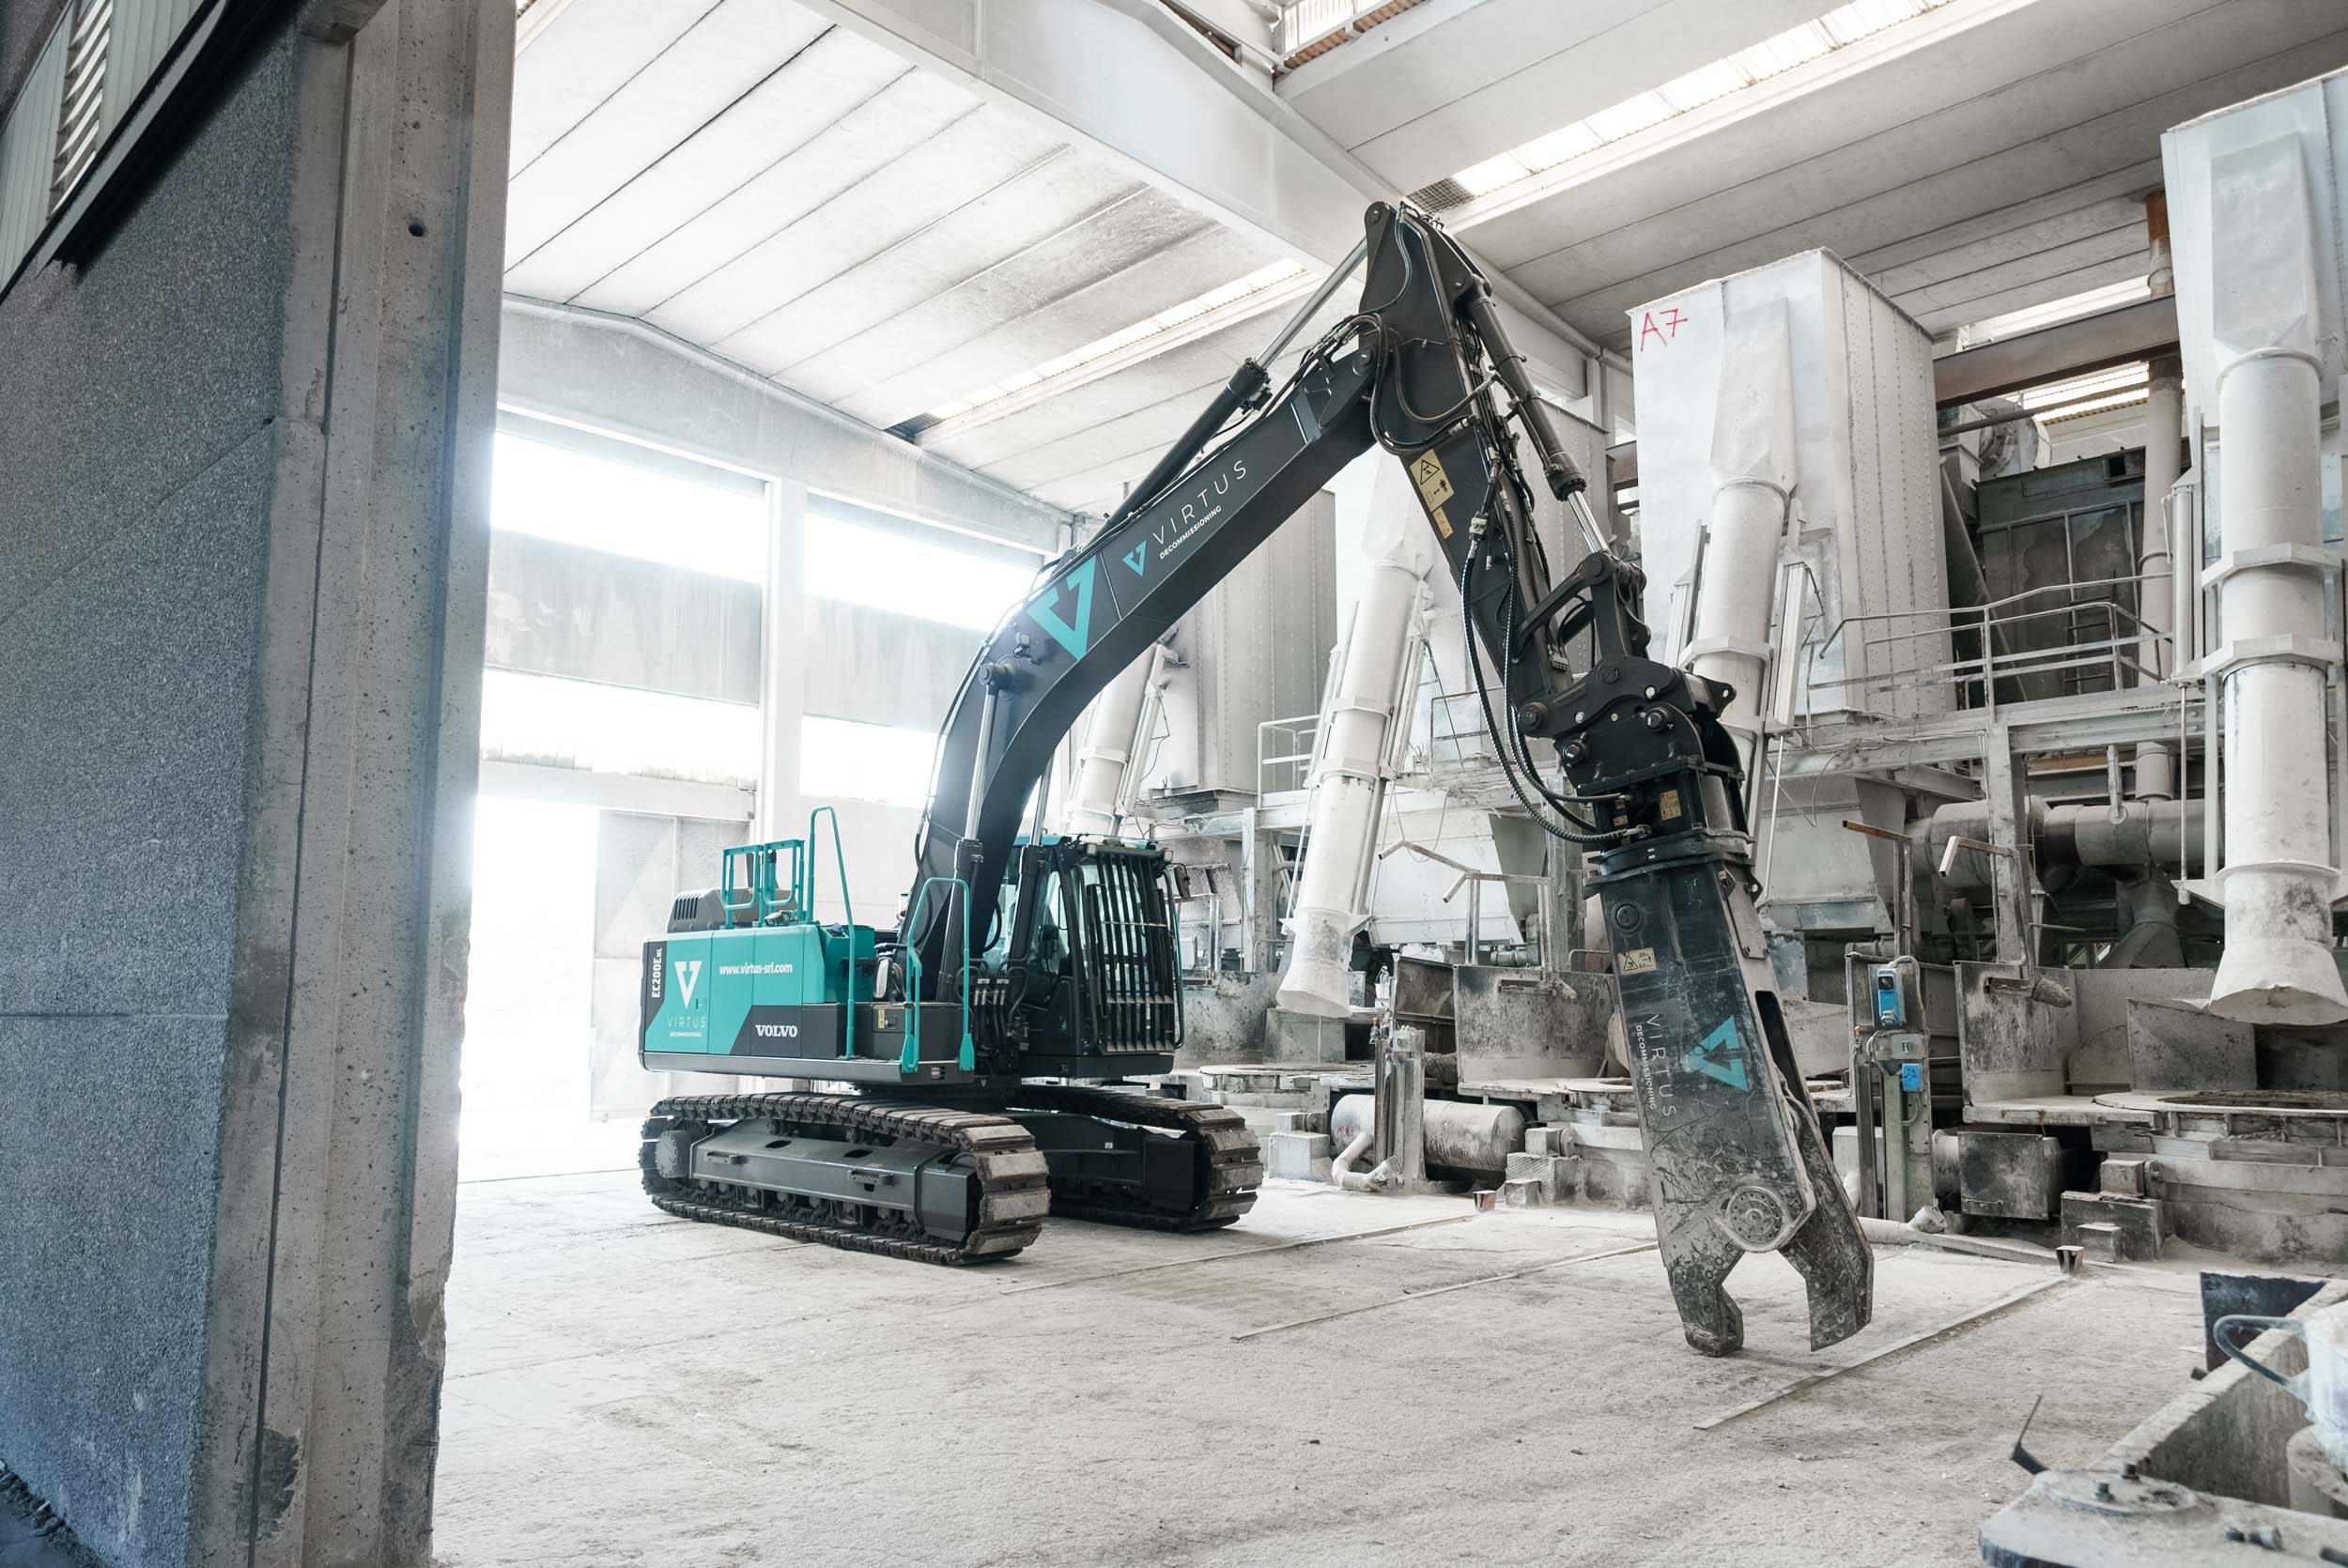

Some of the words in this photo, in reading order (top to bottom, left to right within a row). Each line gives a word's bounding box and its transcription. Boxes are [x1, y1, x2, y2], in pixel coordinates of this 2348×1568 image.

[1640, 307, 1689, 352] A7
[1152, 459, 1247, 546] VIRTUS
[1159, 504, 1222, 561] DECOMMISSIONING
[719, 961, 793, 976] www.virtus-srl.com
[667, 1015, 706, 1029] VIRTUS
[755, 1023, 798, 1038] VOLVO
[1635, 1024, 1657, 1111] DECOMMISSIONING
[1646, 1014, 1676, 1116] VIRTUS
